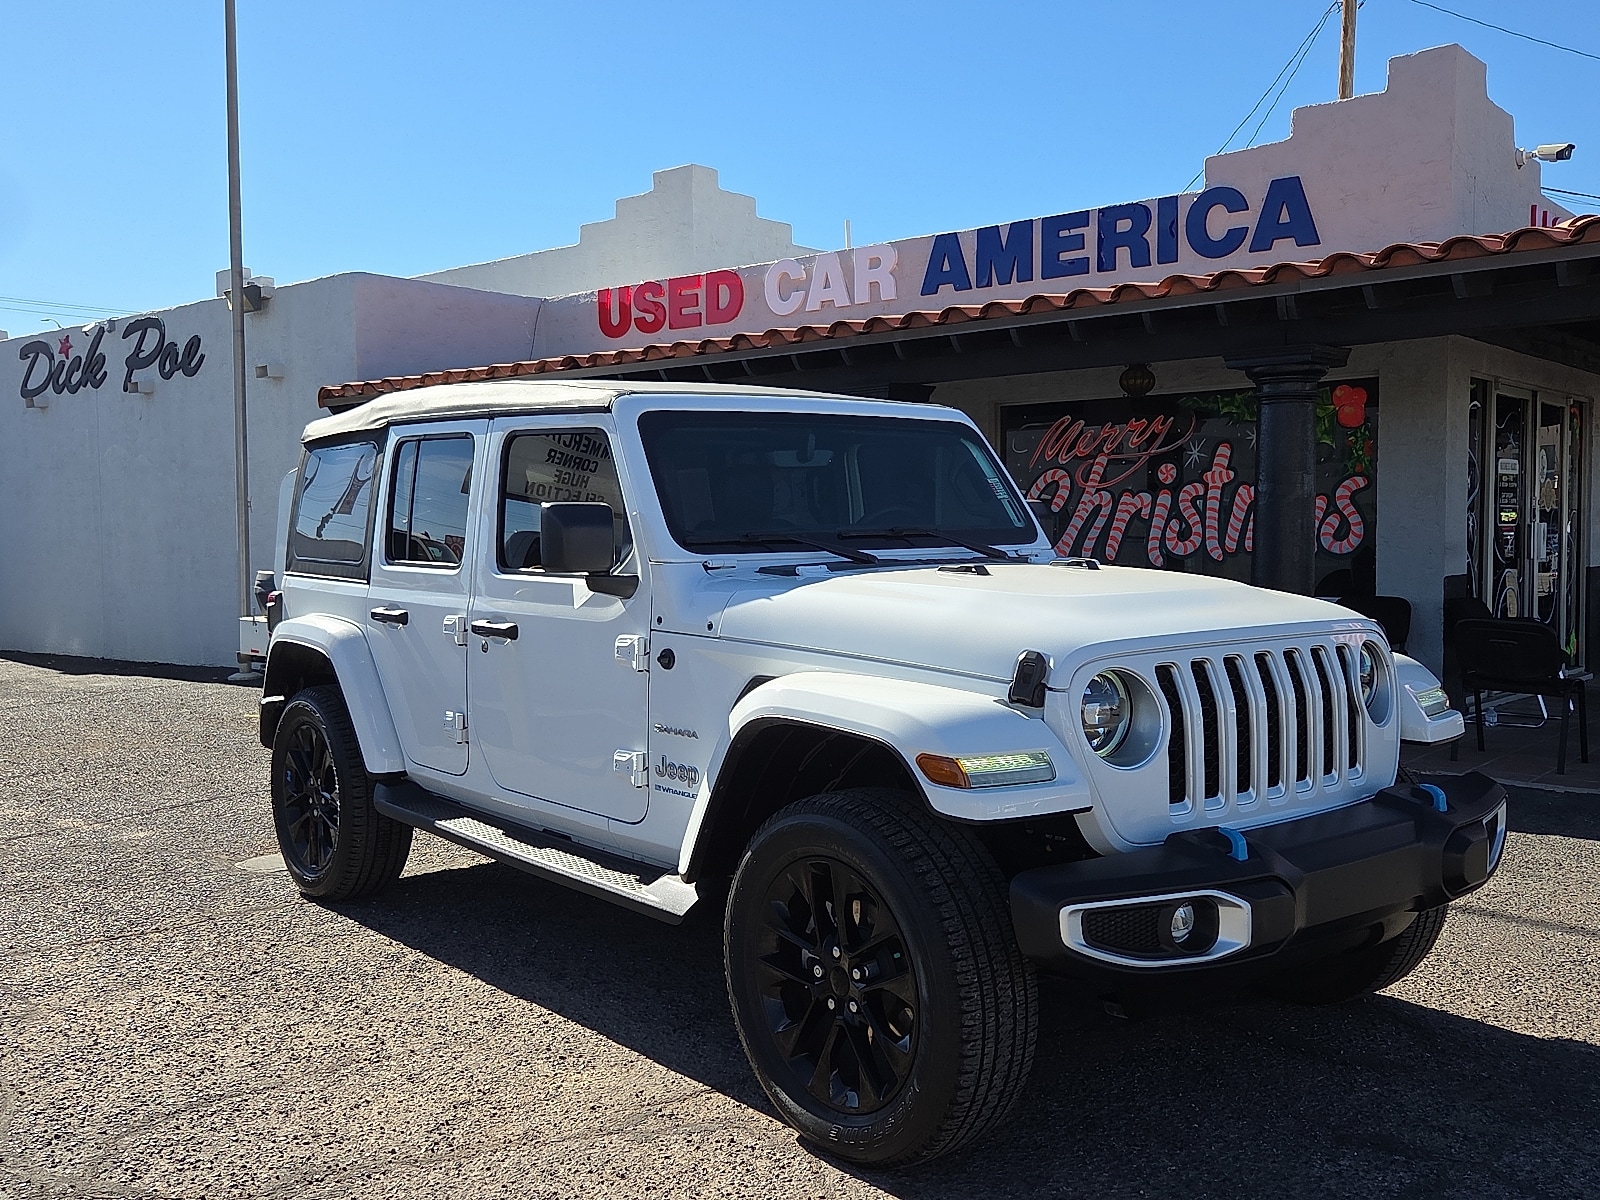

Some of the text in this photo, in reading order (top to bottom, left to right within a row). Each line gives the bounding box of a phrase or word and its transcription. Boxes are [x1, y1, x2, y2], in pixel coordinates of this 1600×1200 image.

[598, 175, 1321, 339] USED CAR AMERICA
[19, 316, 206, 400] Dick Poe
[1029, 414, 1195, 488] Merry
[654, 754, 700, 789] Jeep
